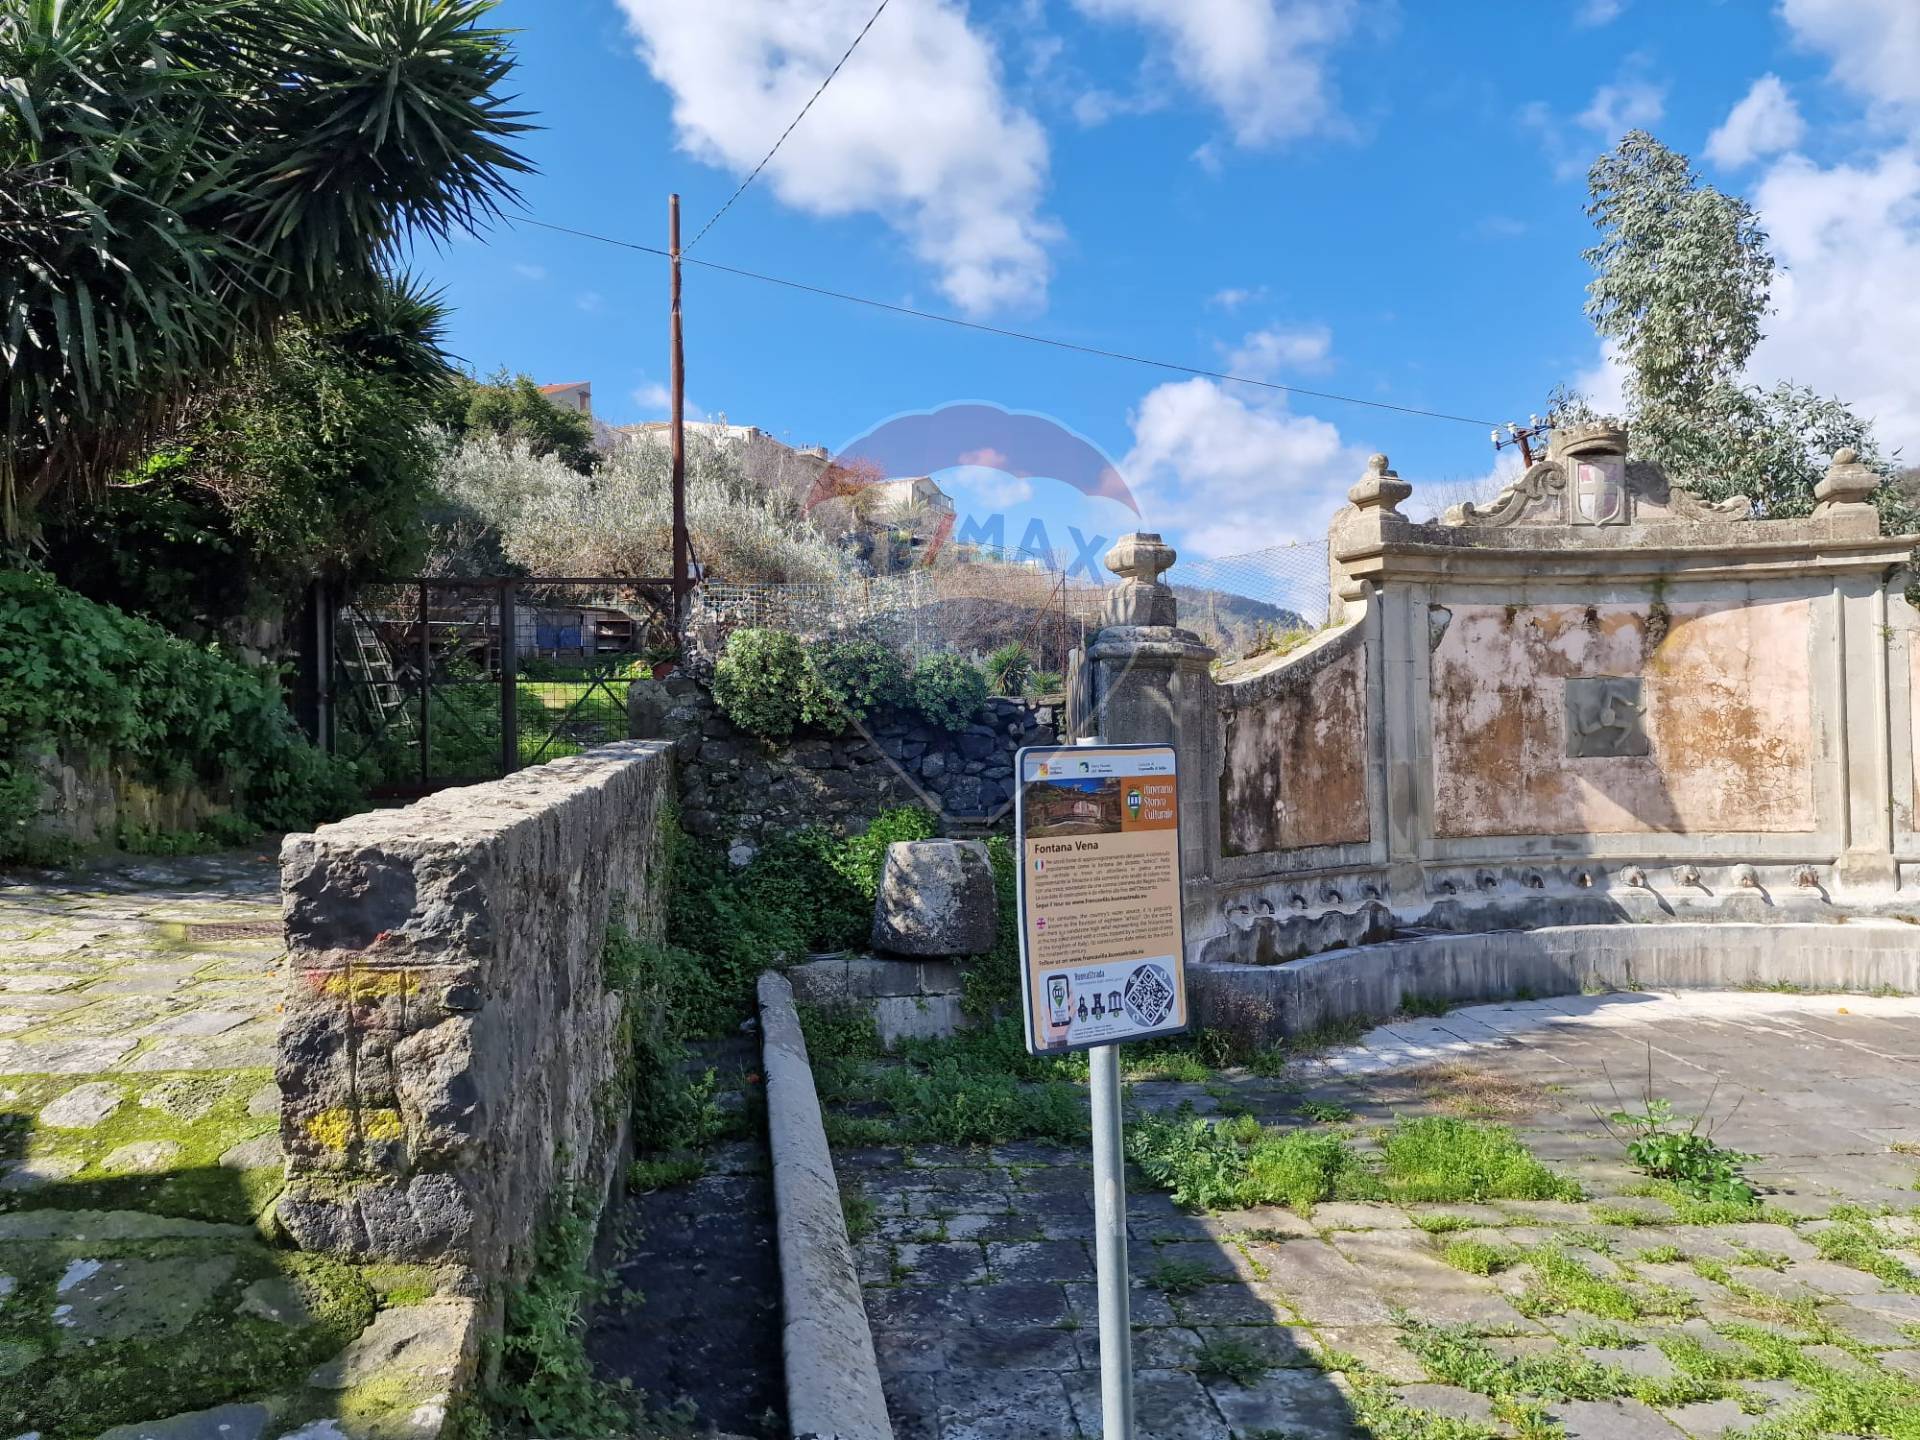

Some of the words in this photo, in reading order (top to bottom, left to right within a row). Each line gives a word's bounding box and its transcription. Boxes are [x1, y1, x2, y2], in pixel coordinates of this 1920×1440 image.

[1144, 808, 1173, 820] Culturale
[1034, 844, 1072, 854] Fontana
[1075, 841, 1098, 851] Vena
